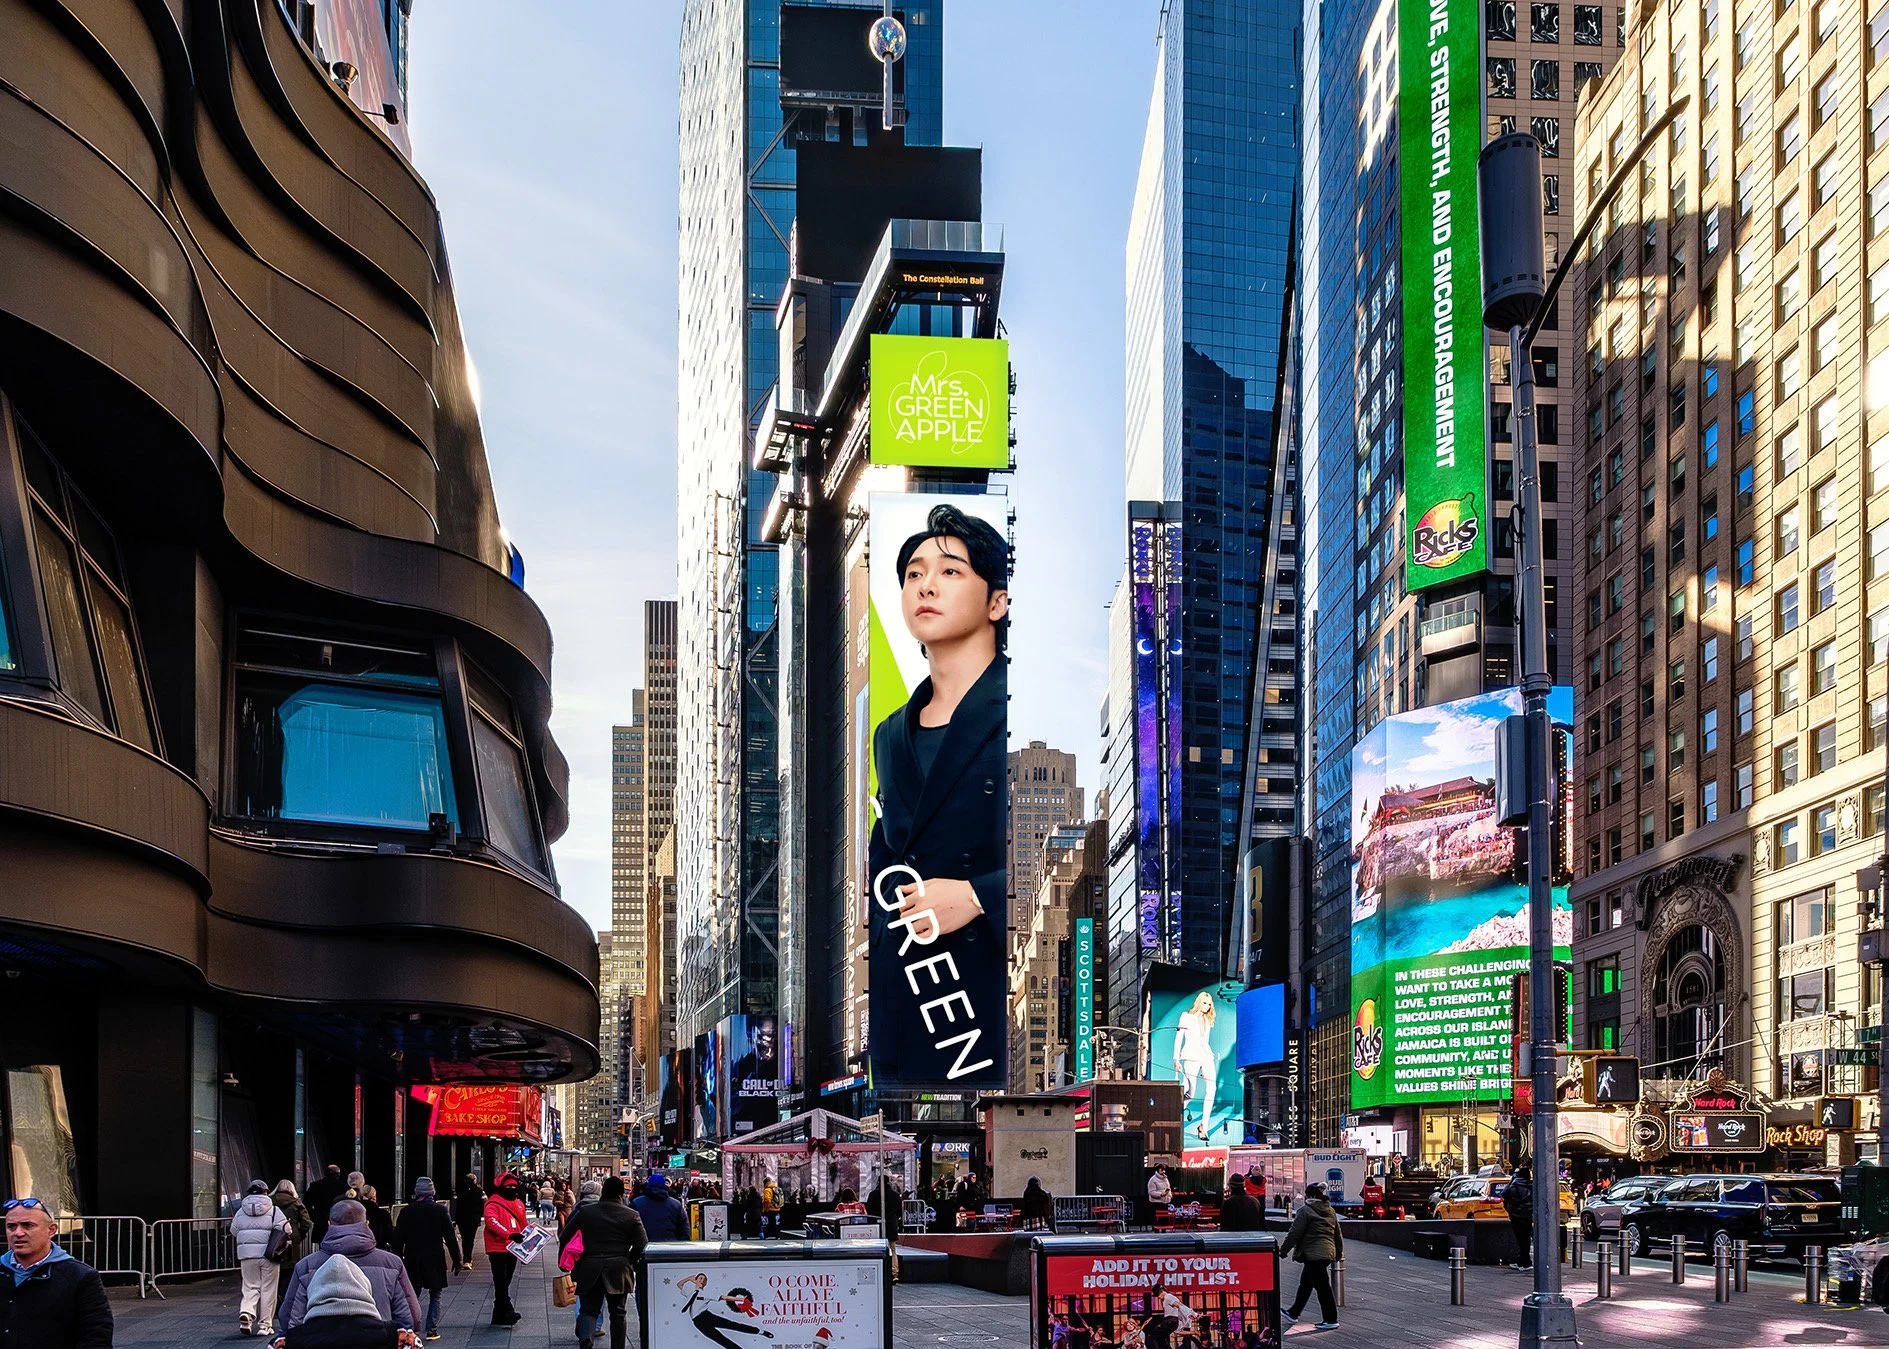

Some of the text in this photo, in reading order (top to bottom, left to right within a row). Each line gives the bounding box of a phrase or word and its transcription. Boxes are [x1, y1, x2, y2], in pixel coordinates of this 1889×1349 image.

[1429, 45, 1450, 188] STRENGTH,
[1432, 190, 1452, 246] AND
[903, 274, 984, 286] The Constellation Ball
[1433, 247, 1455, 468] ENCOURAGEMENT
[910, 373, 969, 397] Mrs.
[895, 396, 983, 420] GREEN
[895, 419, 983, 443] APPLE
[874, 864, 993, 1080] GREEN
[1395, 971, 1408, 982] IN
[1409, 968, 1447, 980] THESE
[1395, 983, 1429, 996] WANT
[1431, 981, 1448, 992] TO
[1450, 978, 1480, 990] TAKE
[1482, 976, 1492, 987] A
[1079, 940, 1090, 1078] SCOTTSDALE
[1395, 996, 1426, 1010] LOVE,
[1429, 991, 1494, 1007] STRENGTH,
[1395, 1006, 1502, 1024] ENCOURAGEMENT
[1395, 1019, 1512, 1039] ACROSS OUR ISLAN
[1395, 1039, 1448, 1052] JAMAICA
[1450, 1037, 1461, 1048] IS
[1463, 1035, 1496, 1047] BUILT
[1289, 1040, 1298, 1092] SQUARE
[1395, 1051, 1470, 1066] COMMUNITY,
[1472, 1050, 1499, 1061] AND
[1838, 1051, 1848, 1064] W
[1853, 1051, 1867, 1064] 44
[1395, 1063, 1512, 1080] MOMENTS LIKE THE
[742, 1079, 768, 1090] CALL
[1395, 1078, 1512, 1094] VALUES SHINE BRIG
[1694, 1098, 1737, 1109] Hard Rock
[445, 1113, 507, 1124] BAKE SHOP
[1766, 1125, 1825, 1146] Rock Shop
[1092, 1257, 1231, 1273] ADD IT TO YOUR
[768, 1275, 782, 1288] O
[1083, 1271, 1240, 1289] HOLIDAY HIT LIST.
[773, 1288, 834, 1301] ALL YE
[760, 1302, 848, 1316] FAITHFUL
[762, 1317, 777, 1325] and
[778, 1316, 791, 1325] the
[831, 1316, 845, 1324] too!
